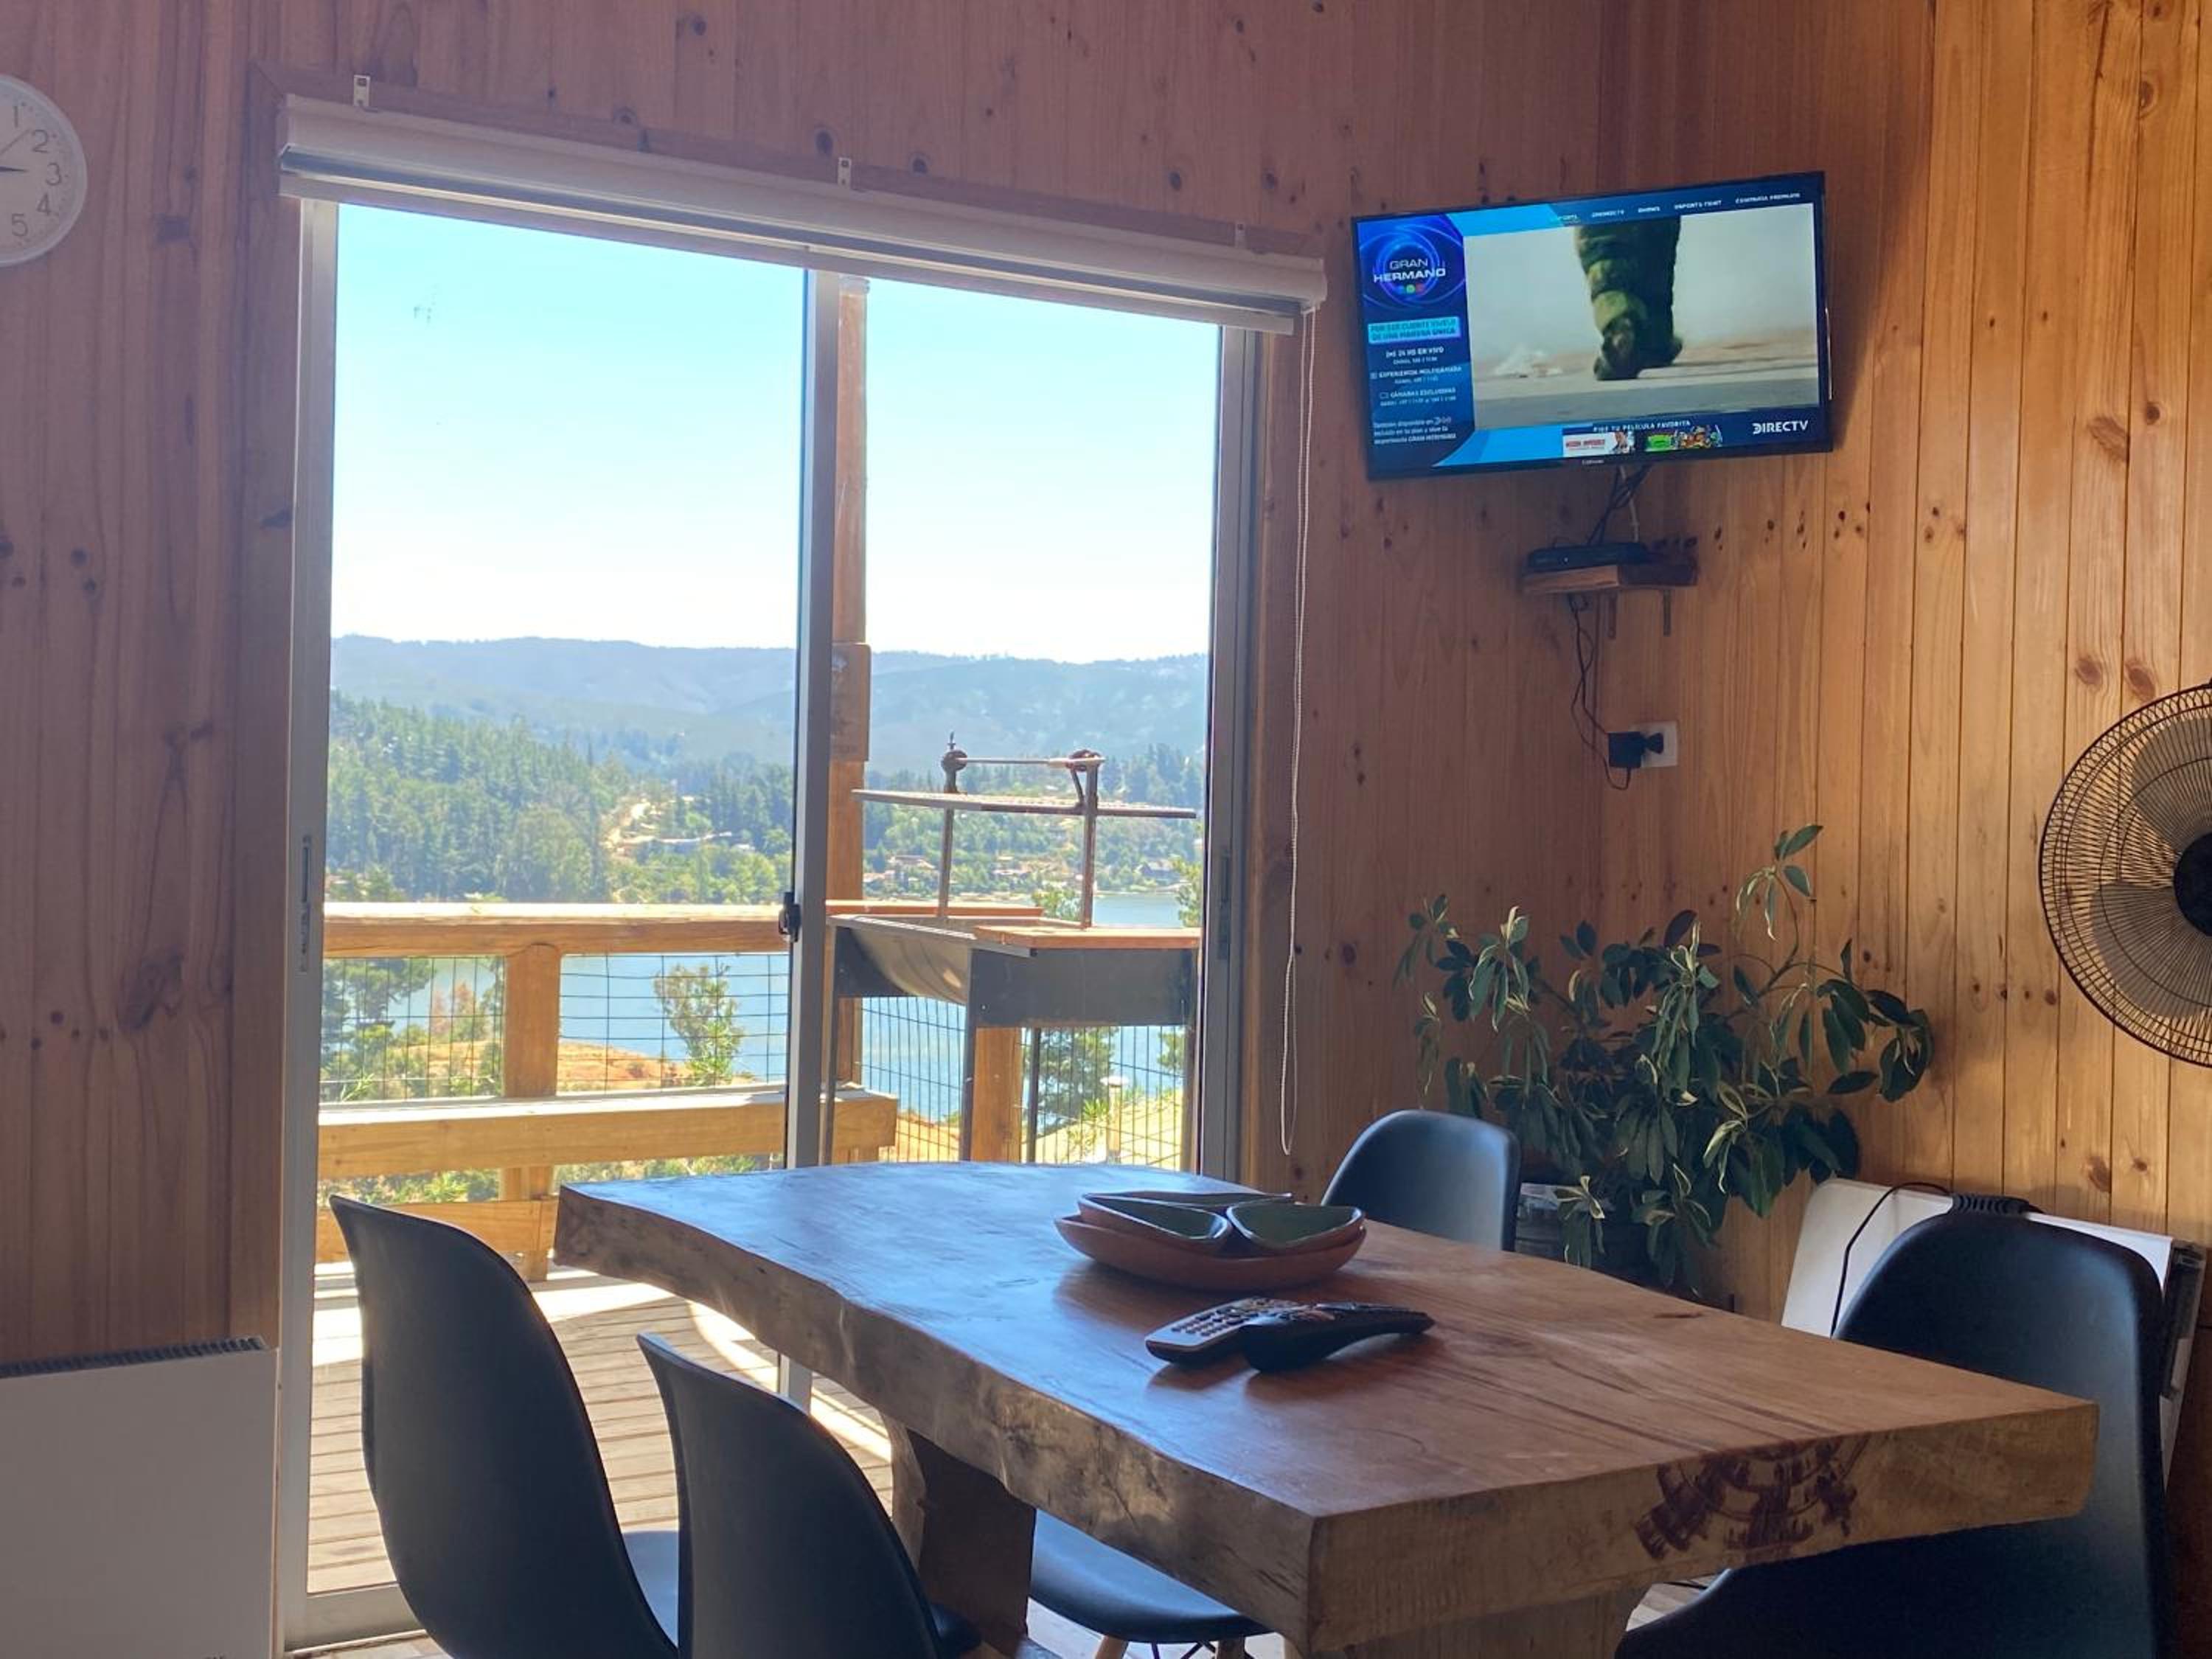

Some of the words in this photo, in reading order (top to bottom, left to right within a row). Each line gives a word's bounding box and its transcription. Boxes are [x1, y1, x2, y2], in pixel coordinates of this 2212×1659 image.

[13, 105, 18, 128] 1
[32, 129, 48, 153] 2
[45, 162, 61, 186] 3
[37, 192, 51, 215] 4
[12, 213, 28, 237] 5
[1374, 268, 1446, 283] HERMANO
[1389, 258, 1428, 270] GRAN
[1753, 420, 1809, 434] DIRECTV
